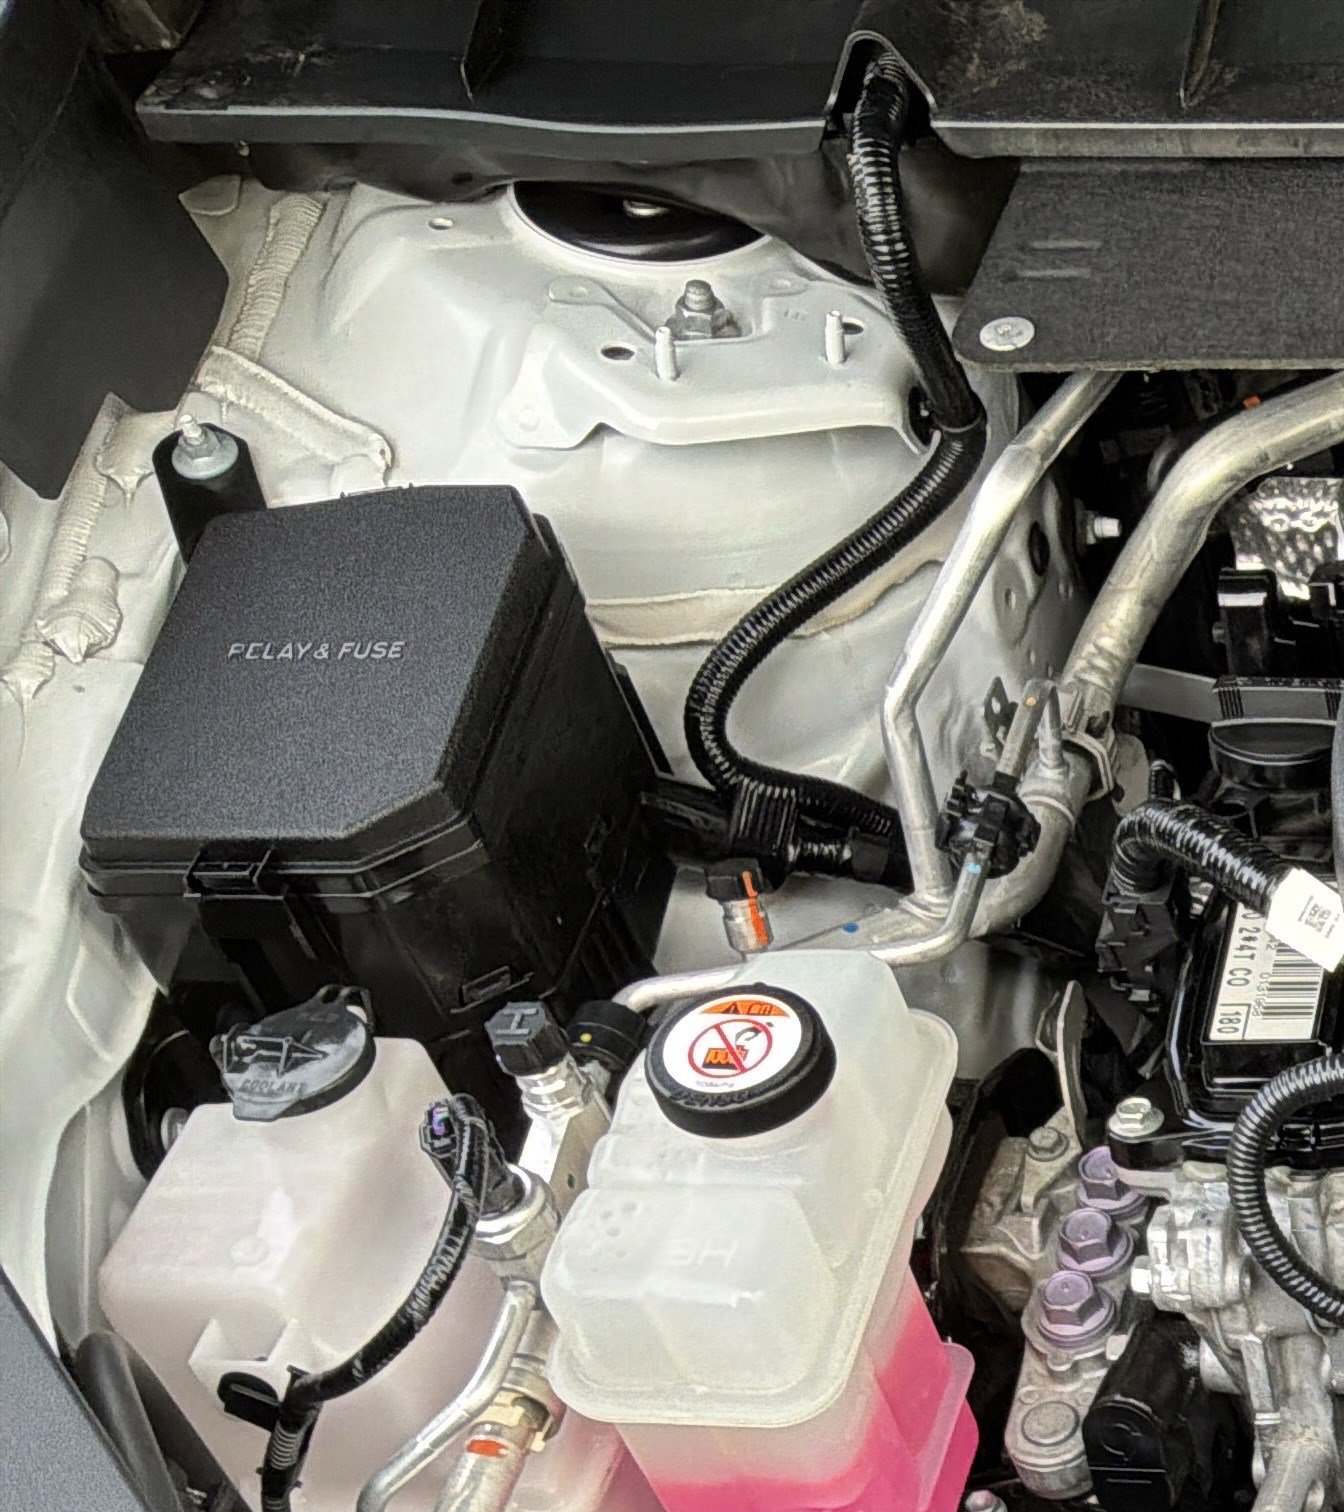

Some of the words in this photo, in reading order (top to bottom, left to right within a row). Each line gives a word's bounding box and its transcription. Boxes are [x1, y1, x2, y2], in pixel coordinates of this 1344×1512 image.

[313, 642, 330, 660] &
[337, 640, 406, 660] FUSE
[1217, 1010, 1242, 1034] 180
